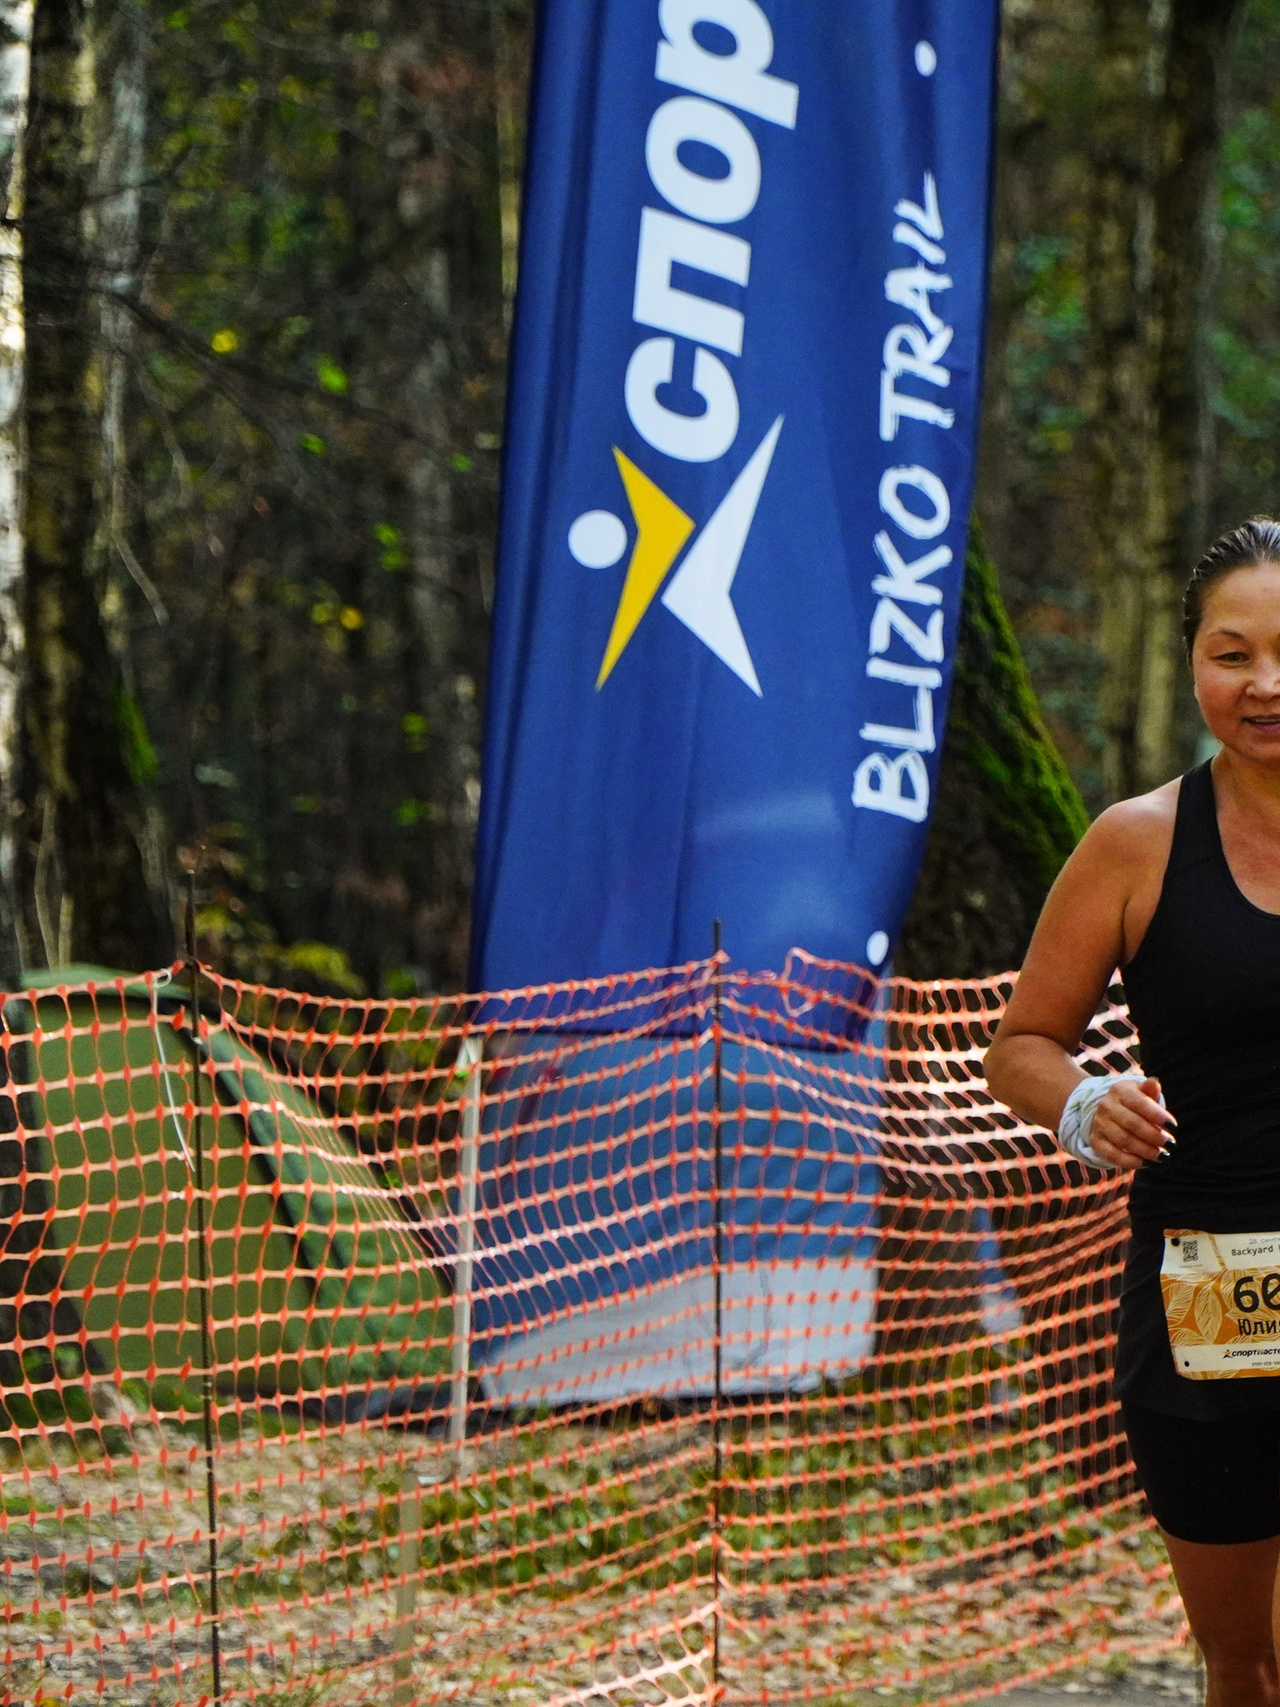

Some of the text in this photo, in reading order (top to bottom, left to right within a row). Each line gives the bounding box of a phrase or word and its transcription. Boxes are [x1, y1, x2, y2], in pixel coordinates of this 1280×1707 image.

[624, 0, 799, 462] спор
[852, 171, 955, 822] BLIZKO TRAIL
[1231, 1244, 1273, 1257] Backyard
